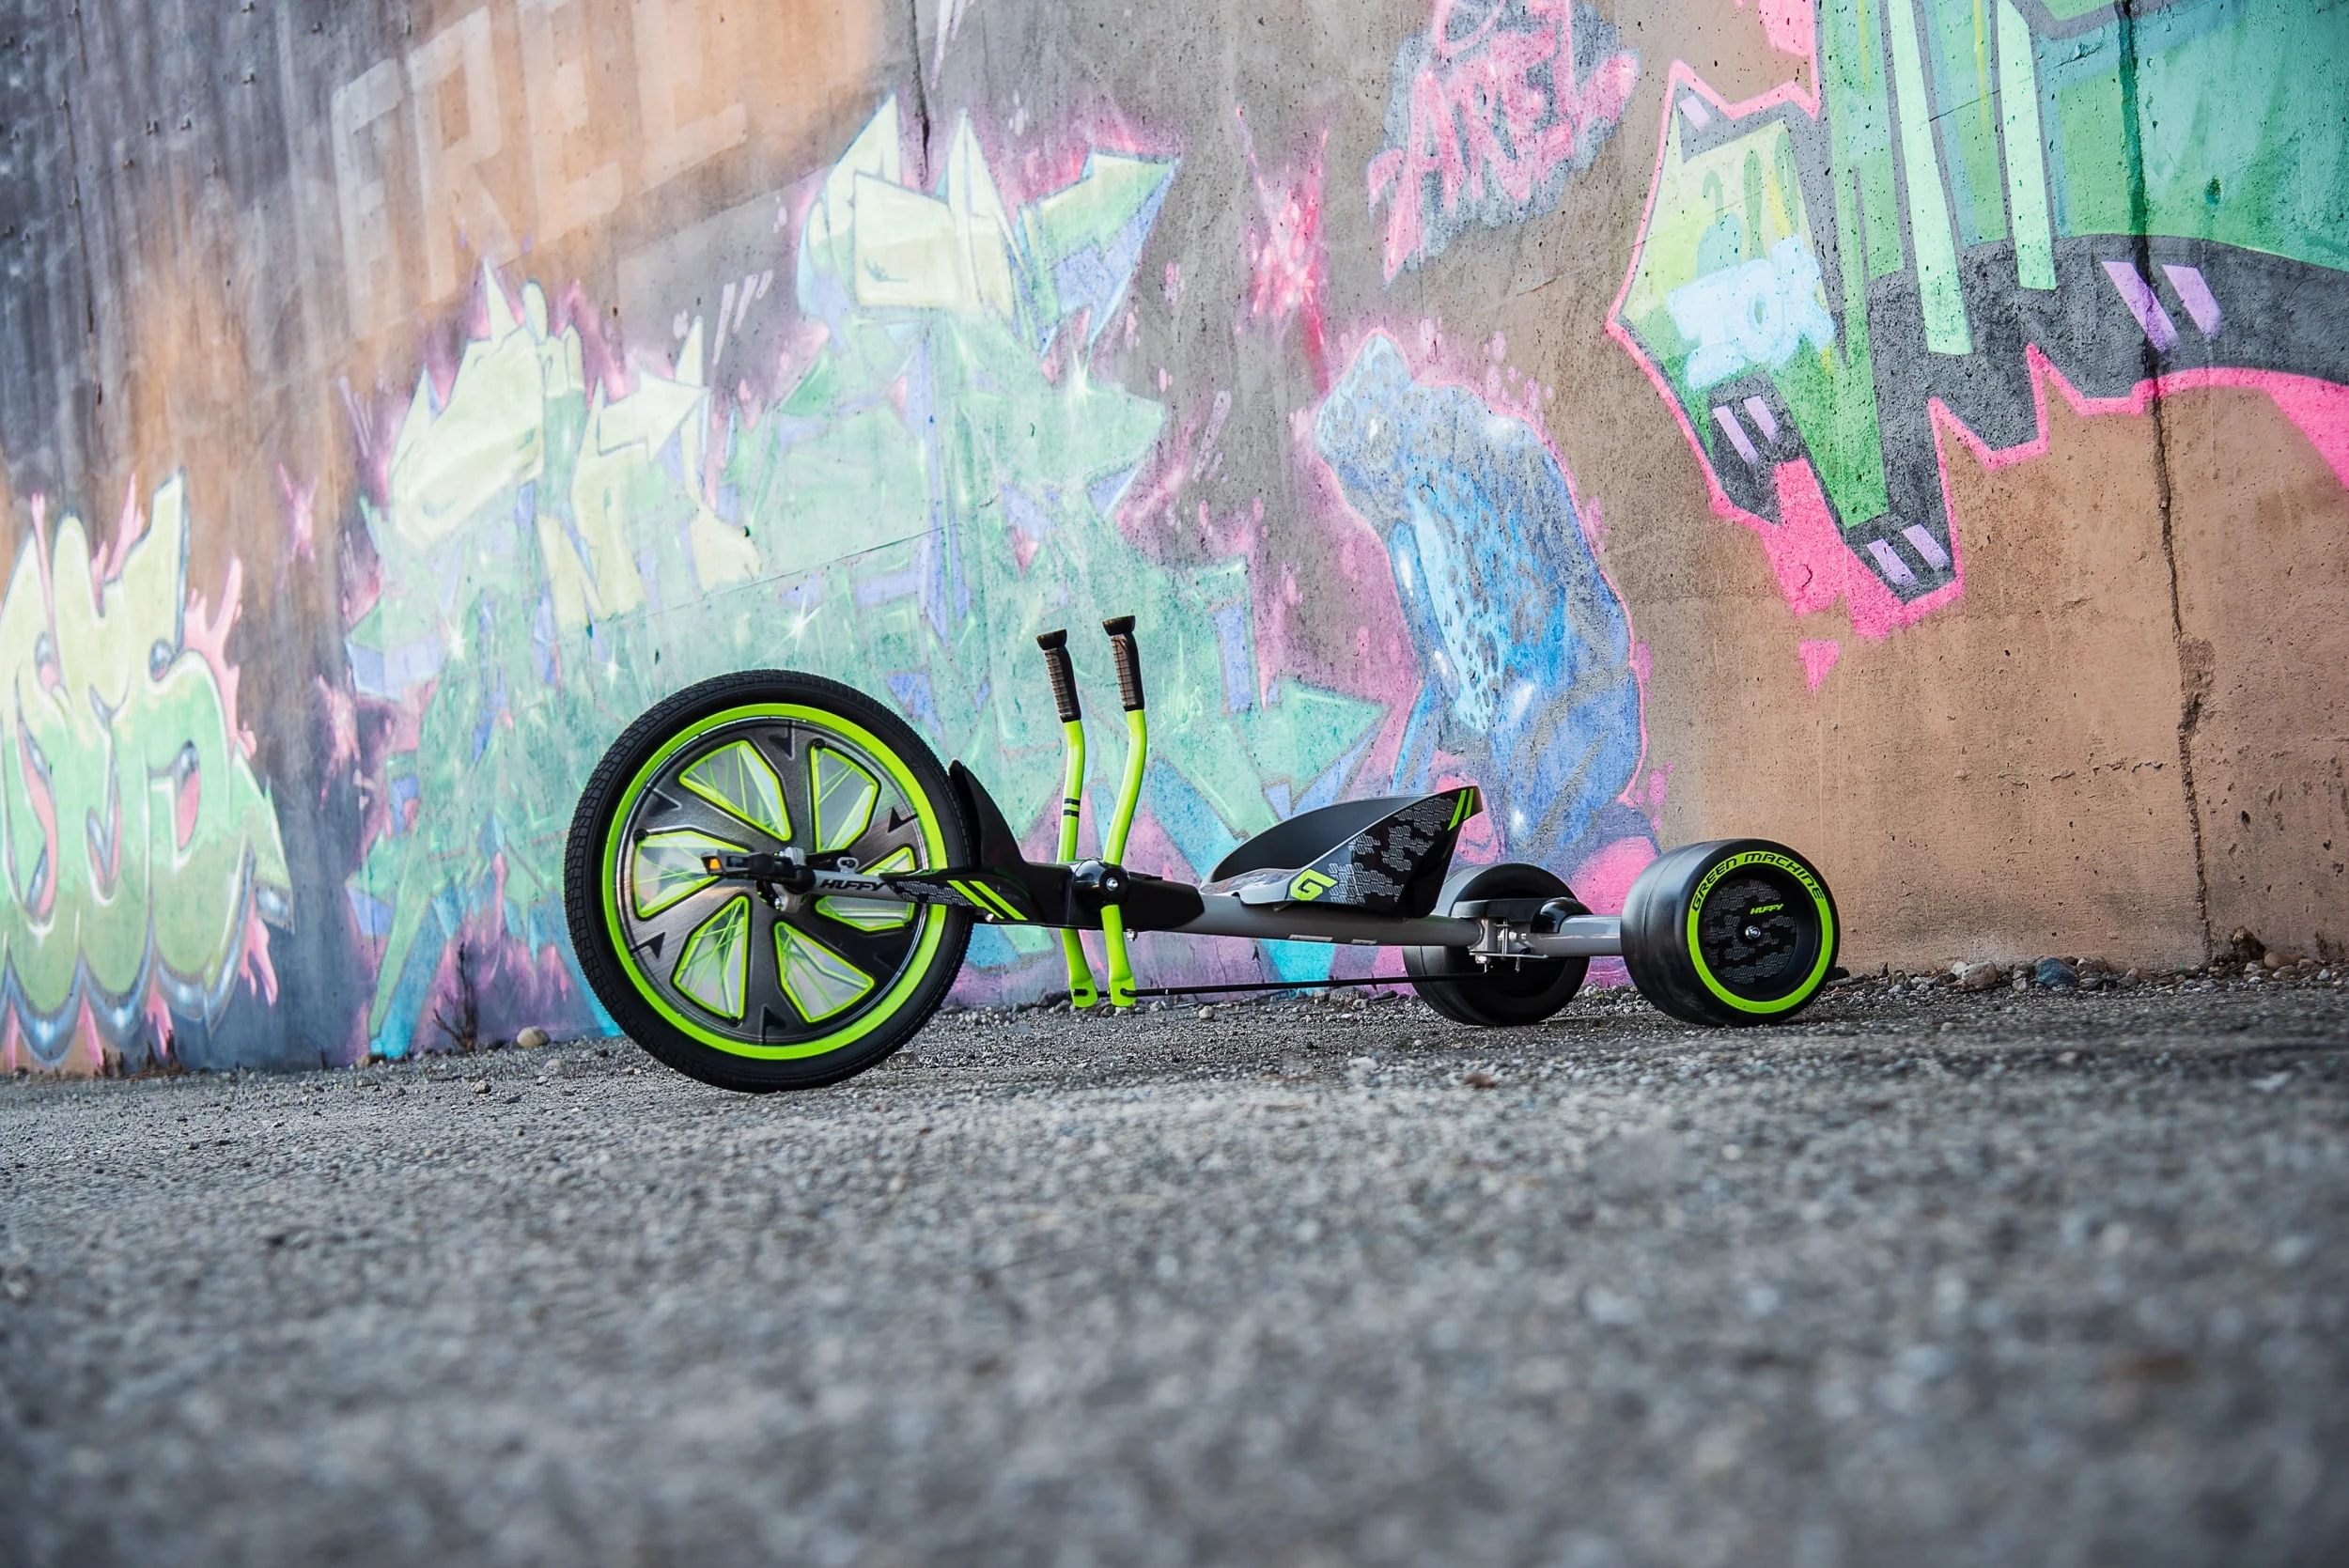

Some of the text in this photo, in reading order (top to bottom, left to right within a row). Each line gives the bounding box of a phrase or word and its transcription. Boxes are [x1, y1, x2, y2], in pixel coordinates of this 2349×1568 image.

[819, 878, 886, 892] HUFFY
[1692, 852, 1824, 911] GREEN MACHINE
[1750, 903, 1784, 915] HUFFY
